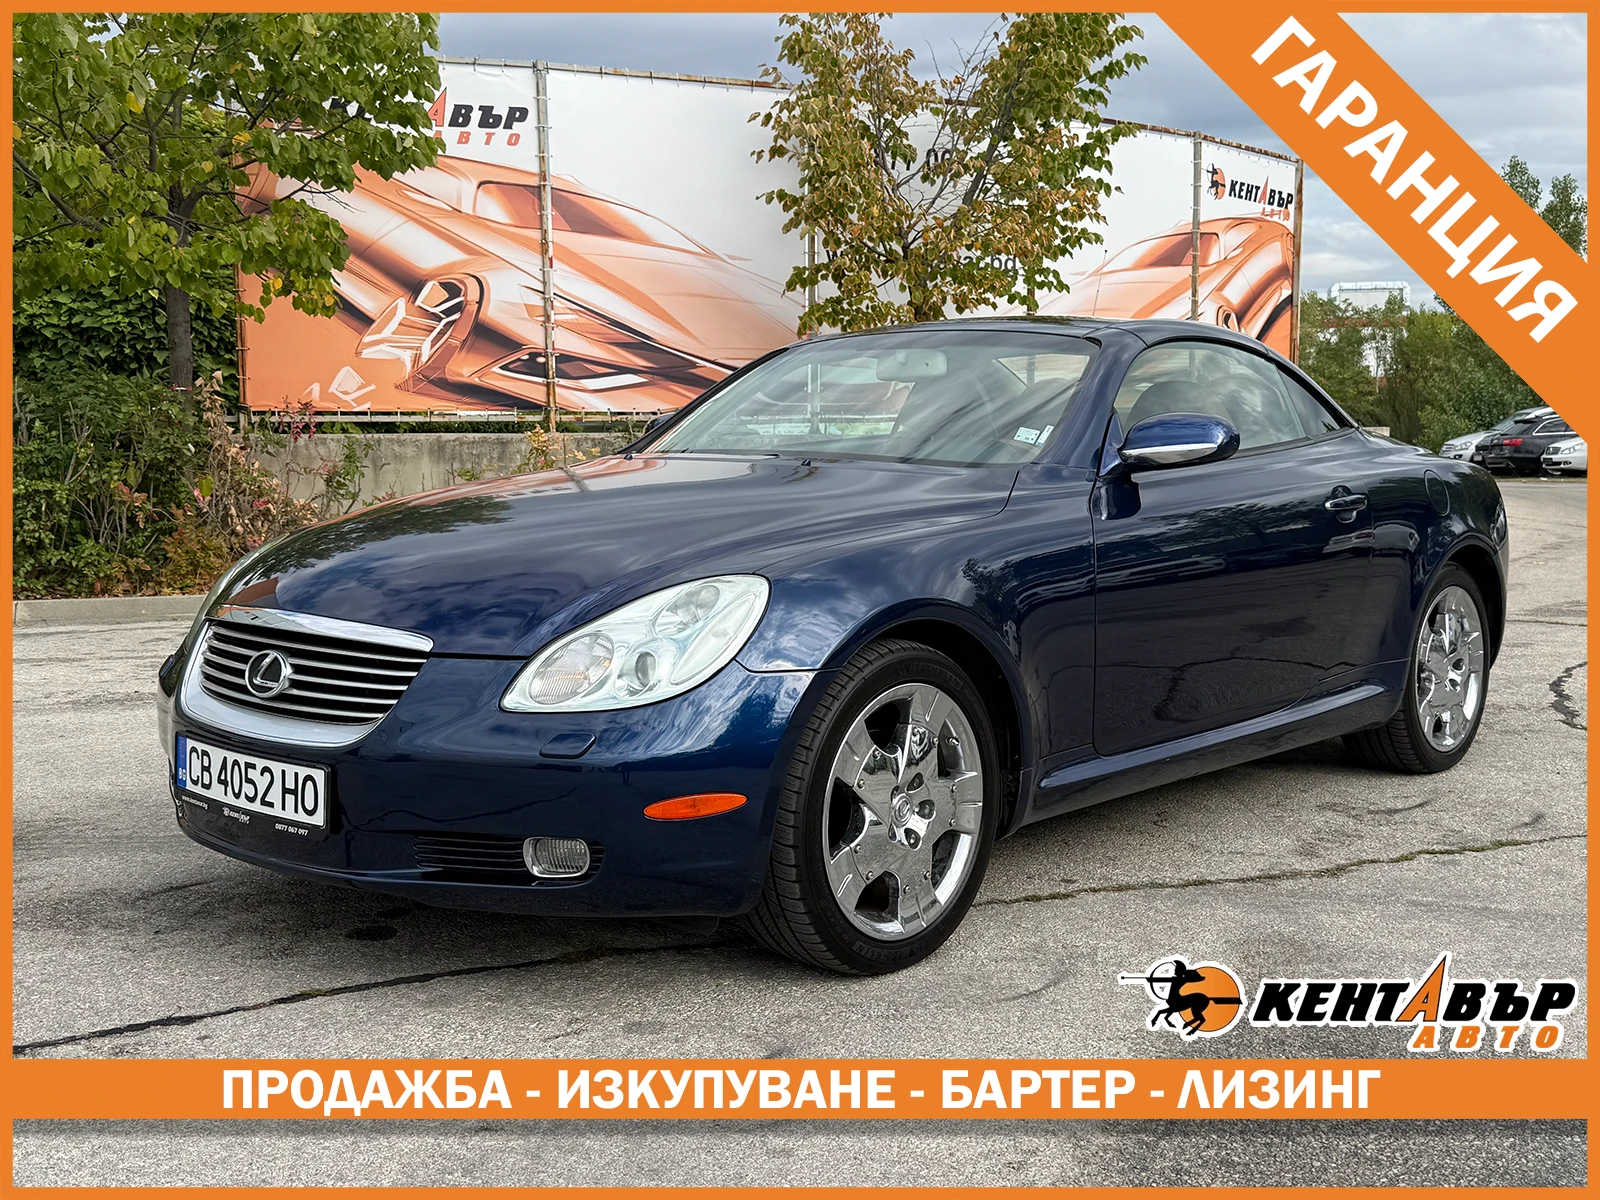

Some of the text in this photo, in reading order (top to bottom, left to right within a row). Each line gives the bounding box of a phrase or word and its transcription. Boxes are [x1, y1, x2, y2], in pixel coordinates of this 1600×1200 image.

[1228, 175, 1294, 209] КЕНТАВЪР
[178, 767, 187, 780] BG
[189, 745, 319, 817] CB 4052 HO
